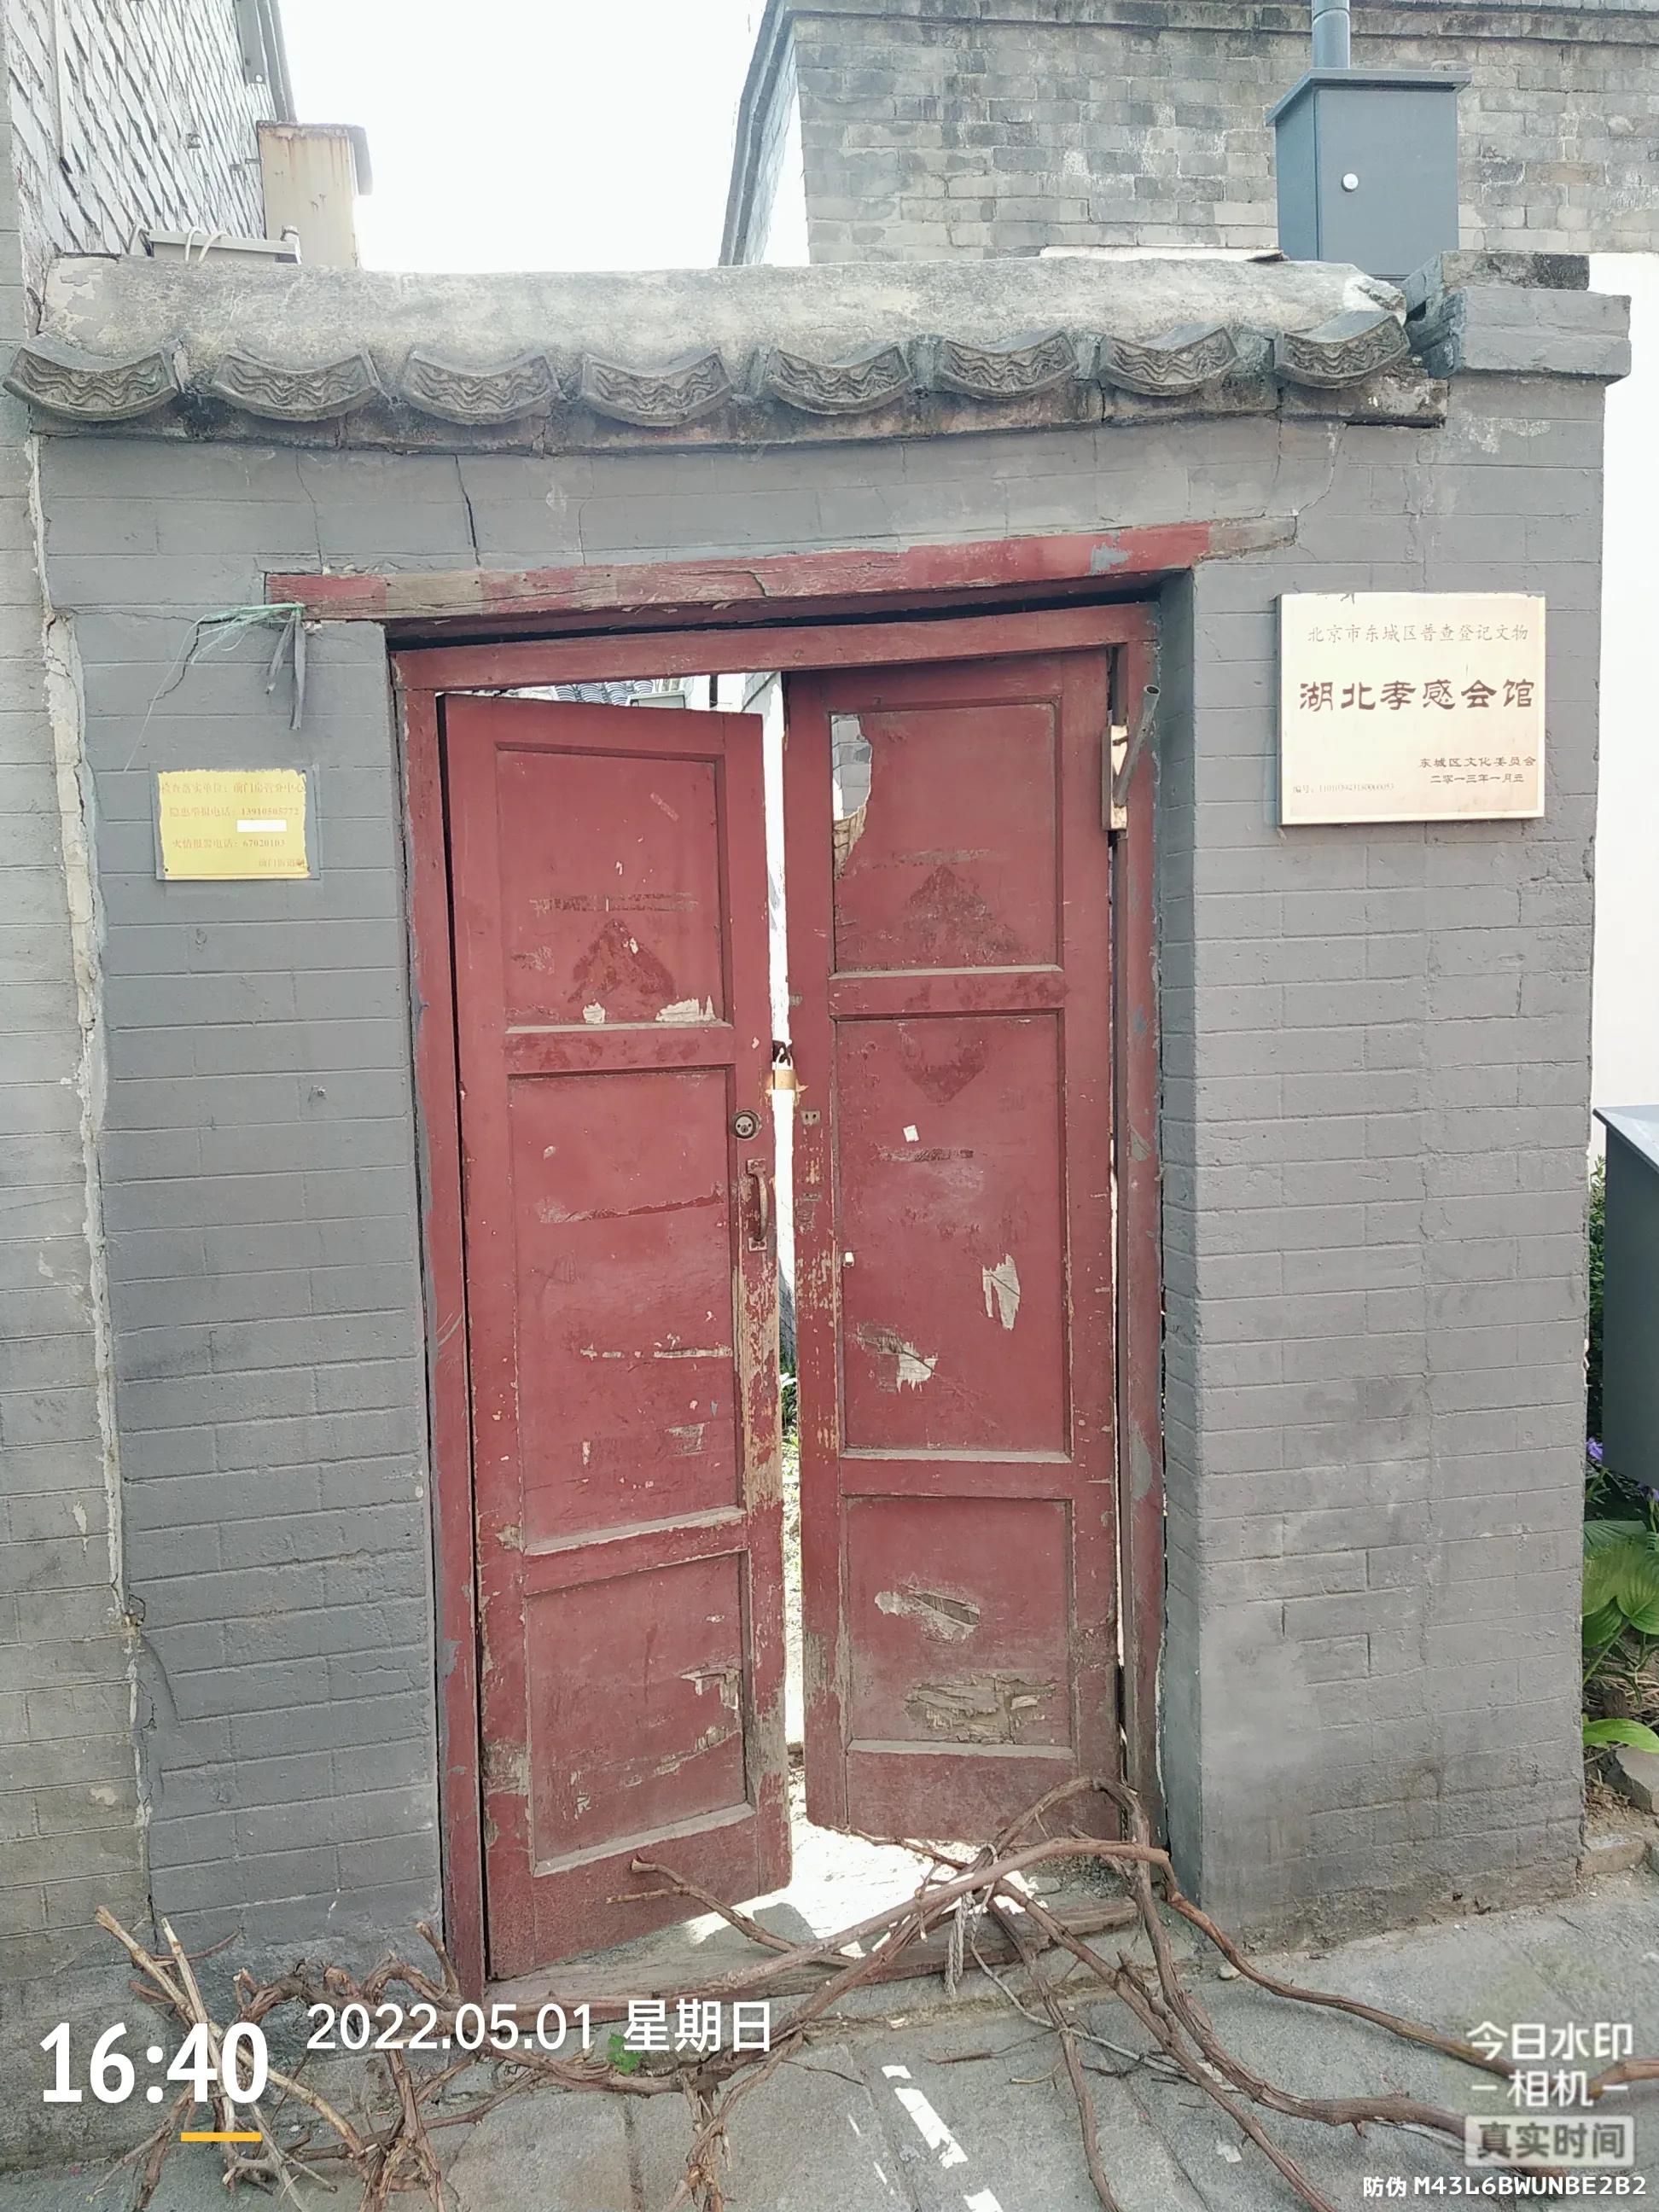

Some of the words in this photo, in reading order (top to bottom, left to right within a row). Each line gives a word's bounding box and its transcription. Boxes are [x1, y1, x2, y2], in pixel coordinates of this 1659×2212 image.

[1307, 623, 1528, 643] 北京市东城区普查登记文物
[1299, 678, 1535, 712] 湖北孝感会馆
[1418, 756, 1537, 768] 东城区文化委员会
